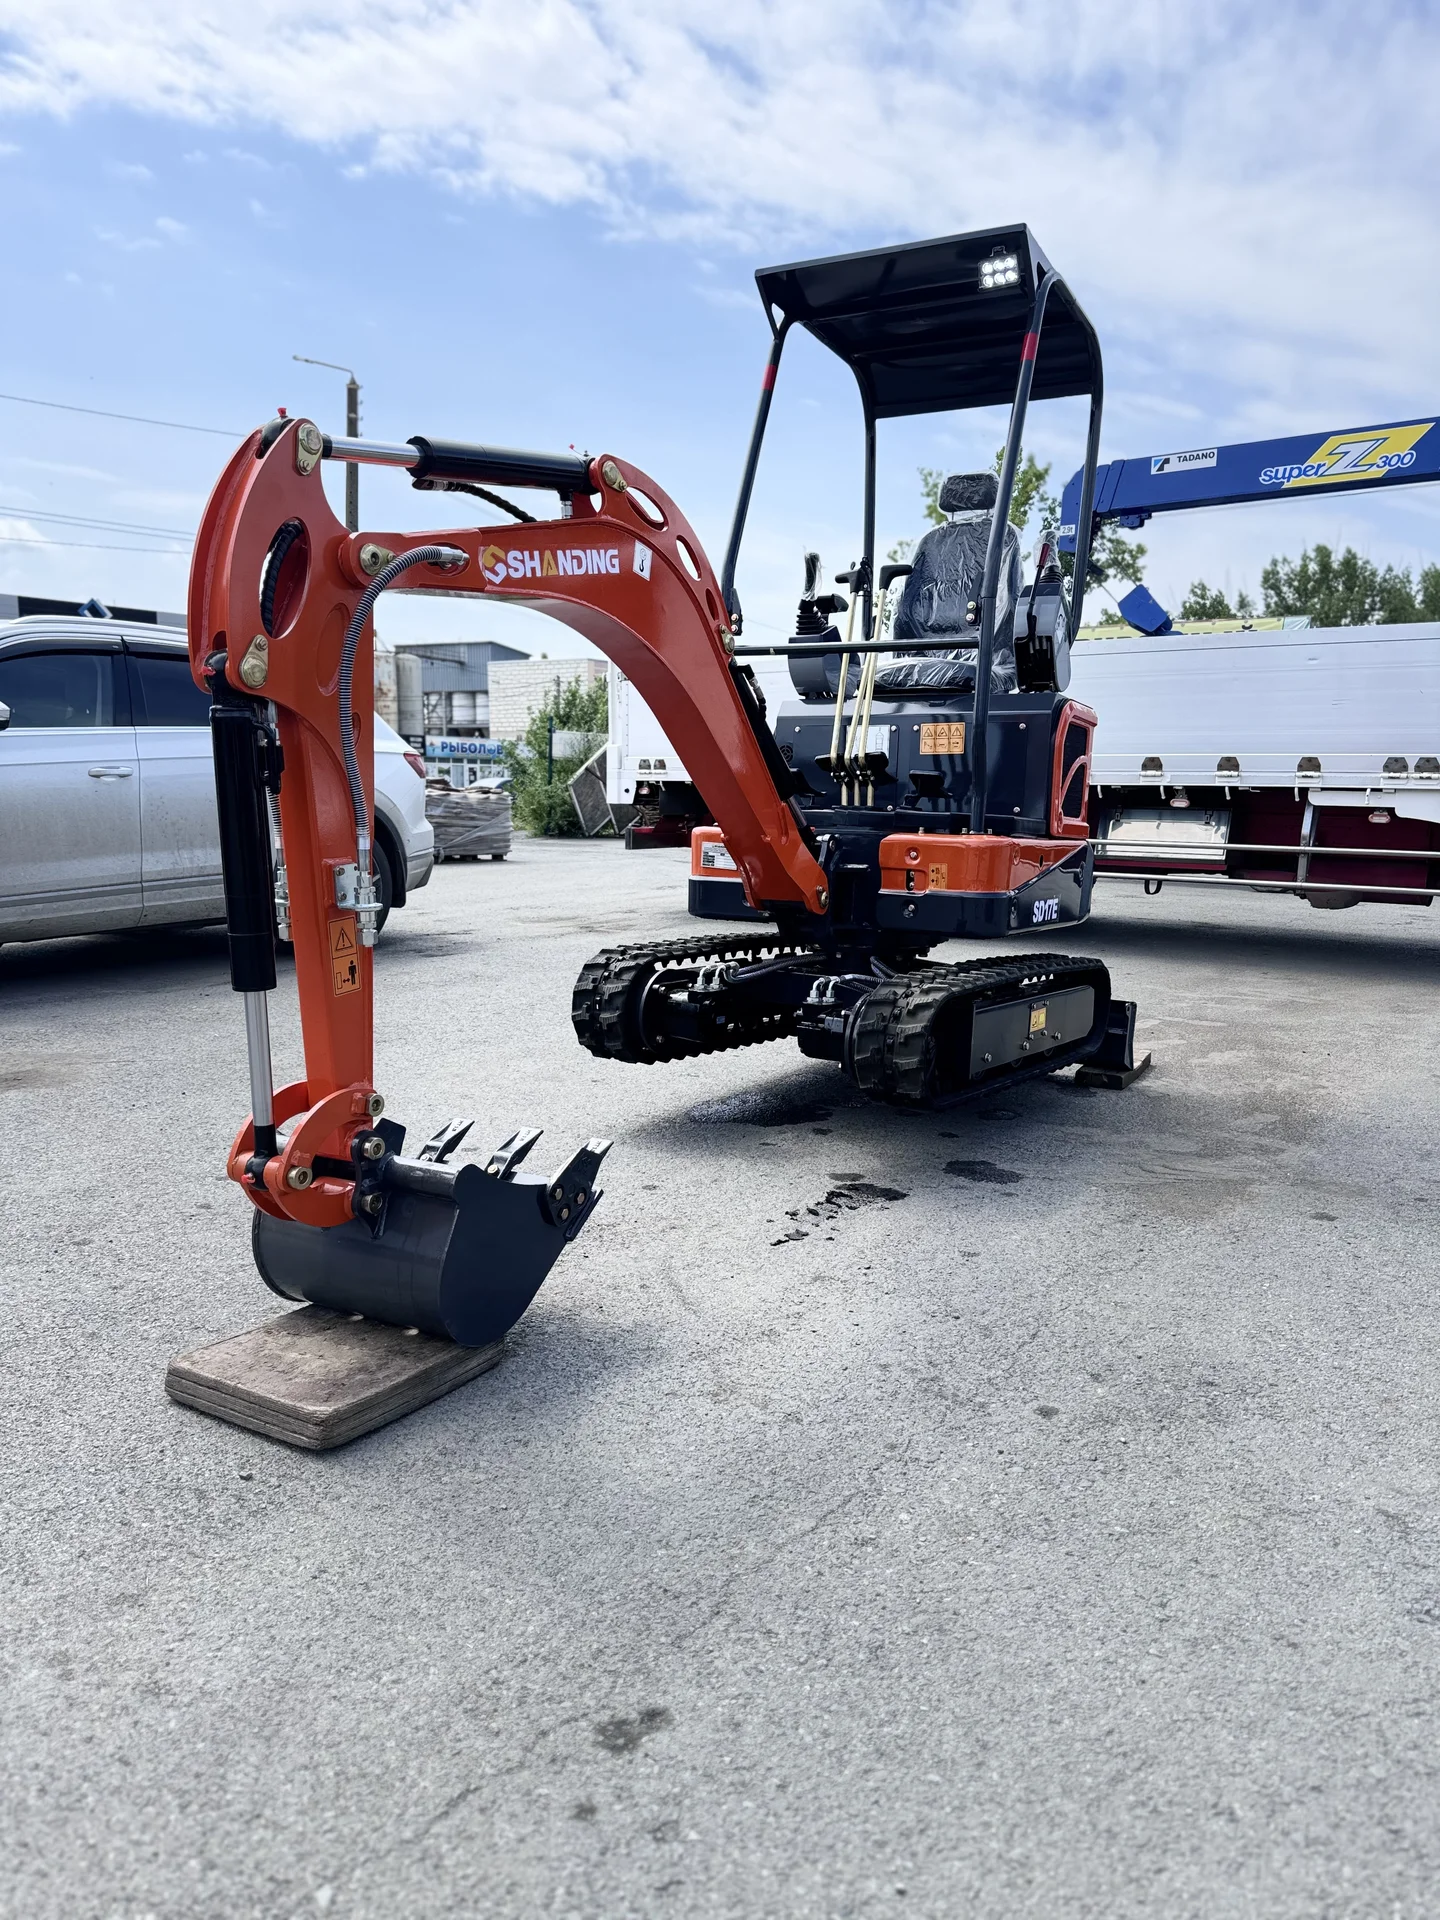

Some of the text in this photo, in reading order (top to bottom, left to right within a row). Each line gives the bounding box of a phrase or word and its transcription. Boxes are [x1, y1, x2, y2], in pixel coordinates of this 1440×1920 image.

[1177, 451, 1215, 463] TADANO
[1376, 452, 1415, 468] 300
[507, 549, 620, 578] SHANDING
[441, 741, 503, 755] РЫБОЛОВ
[1032, 898, 1058, 923] SD17E
